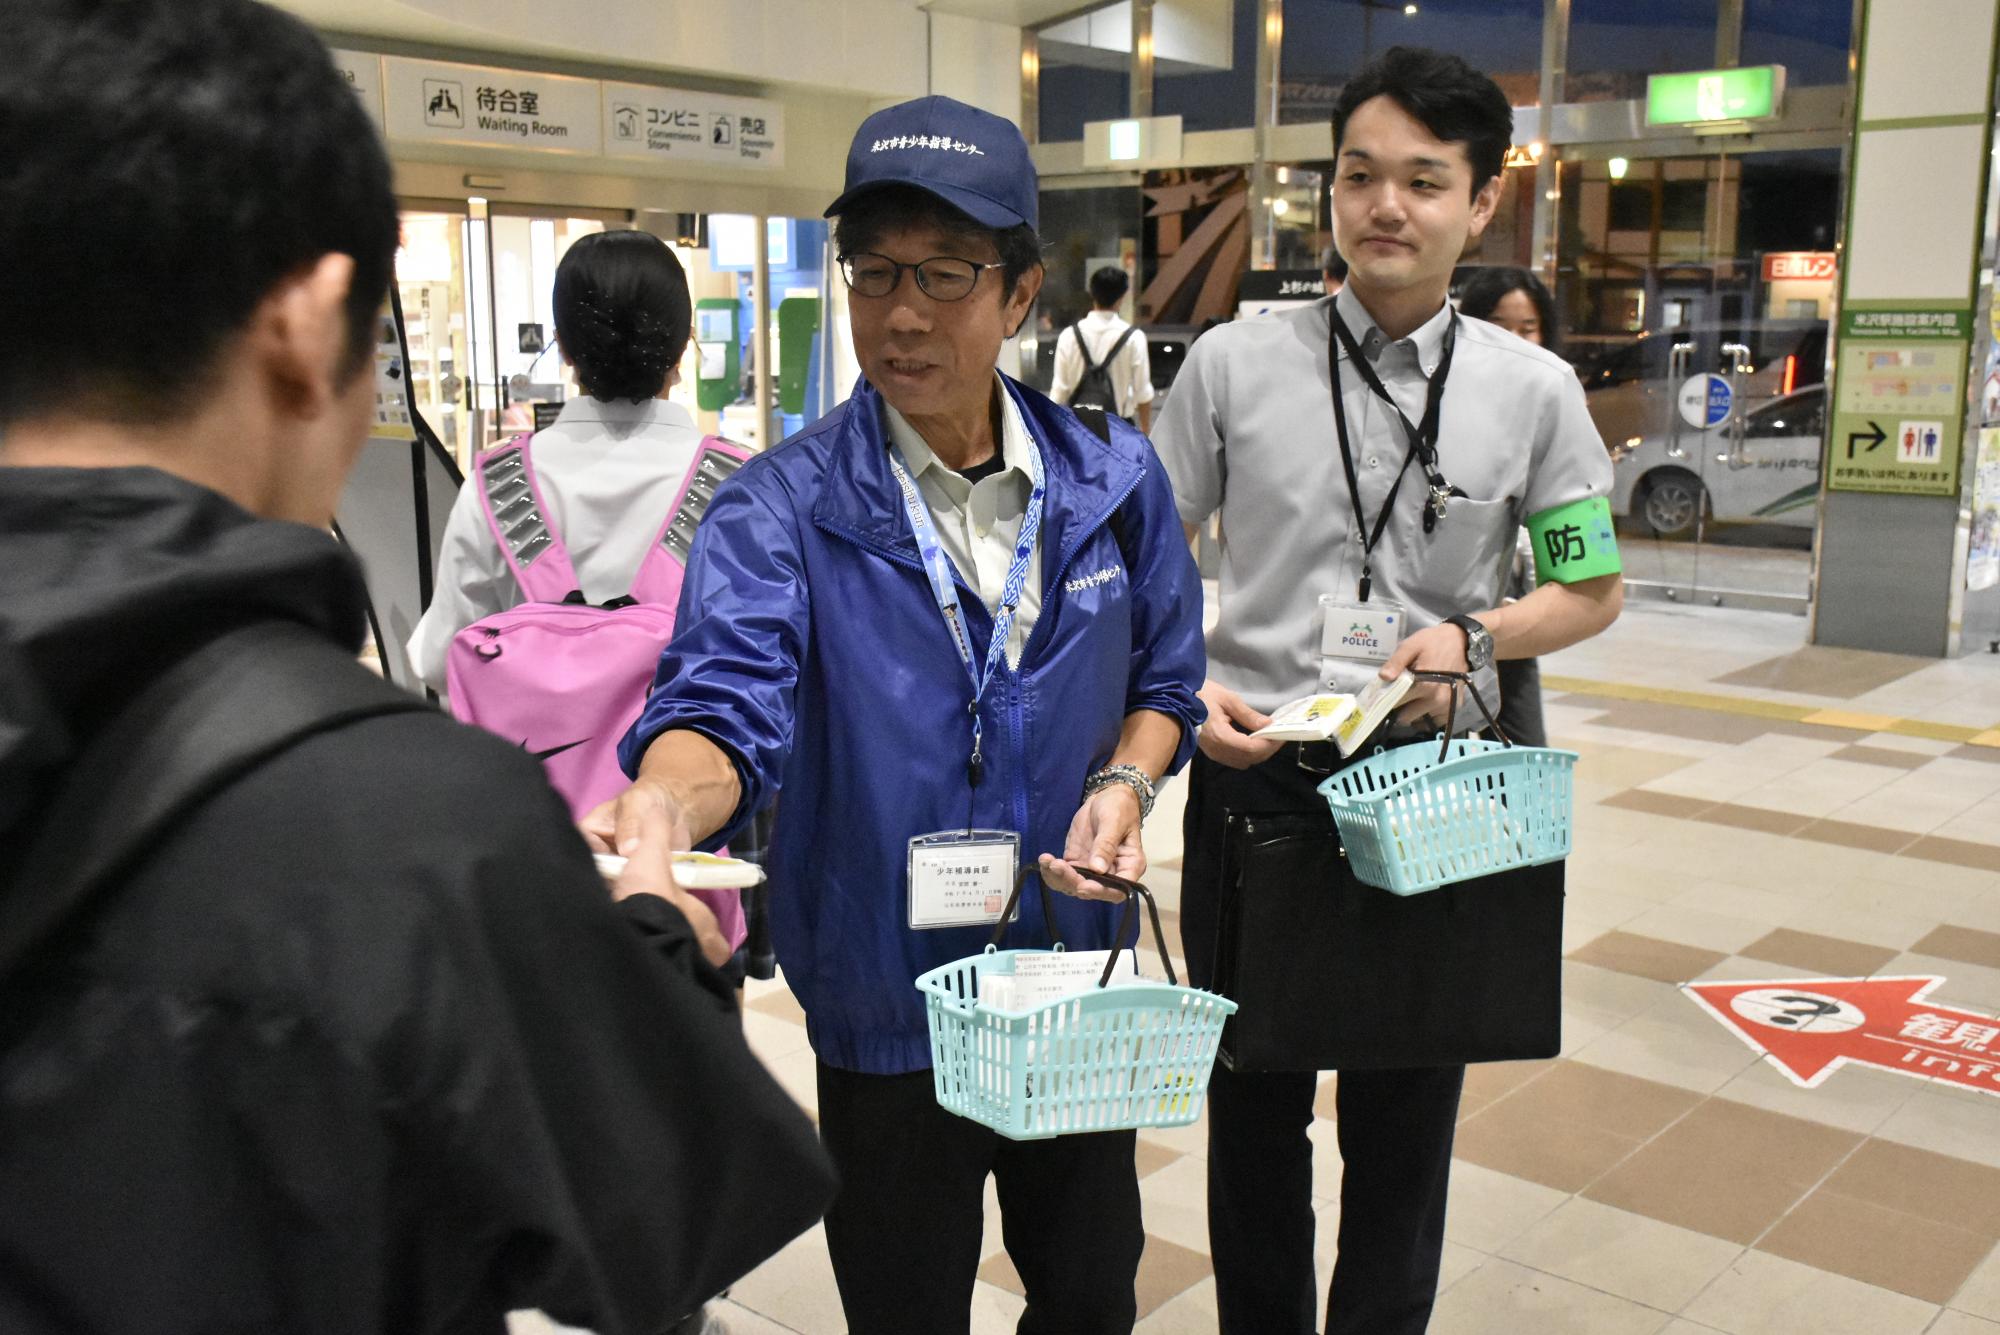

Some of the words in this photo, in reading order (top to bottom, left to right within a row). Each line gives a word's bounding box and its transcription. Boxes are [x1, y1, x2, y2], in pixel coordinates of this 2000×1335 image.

[476, 86, 539, 115] 待合室
[477, 116, 528, 136] Waiting
[532, 121, 568, 136] Room
[647, 108, 700, 127] コンビニ
[740, 117, 765, 135] 売店
[647, 128, 701, 142] Convenience
[647, 139, 671, 151] Store
[870, 135, 985, 156] 米沢市青少年指導センター
[1544, 524, 1585, 567] 防
[1342, 636, 1378, 648] POLICE
[1899, 1013, 2000, 1055] 観
